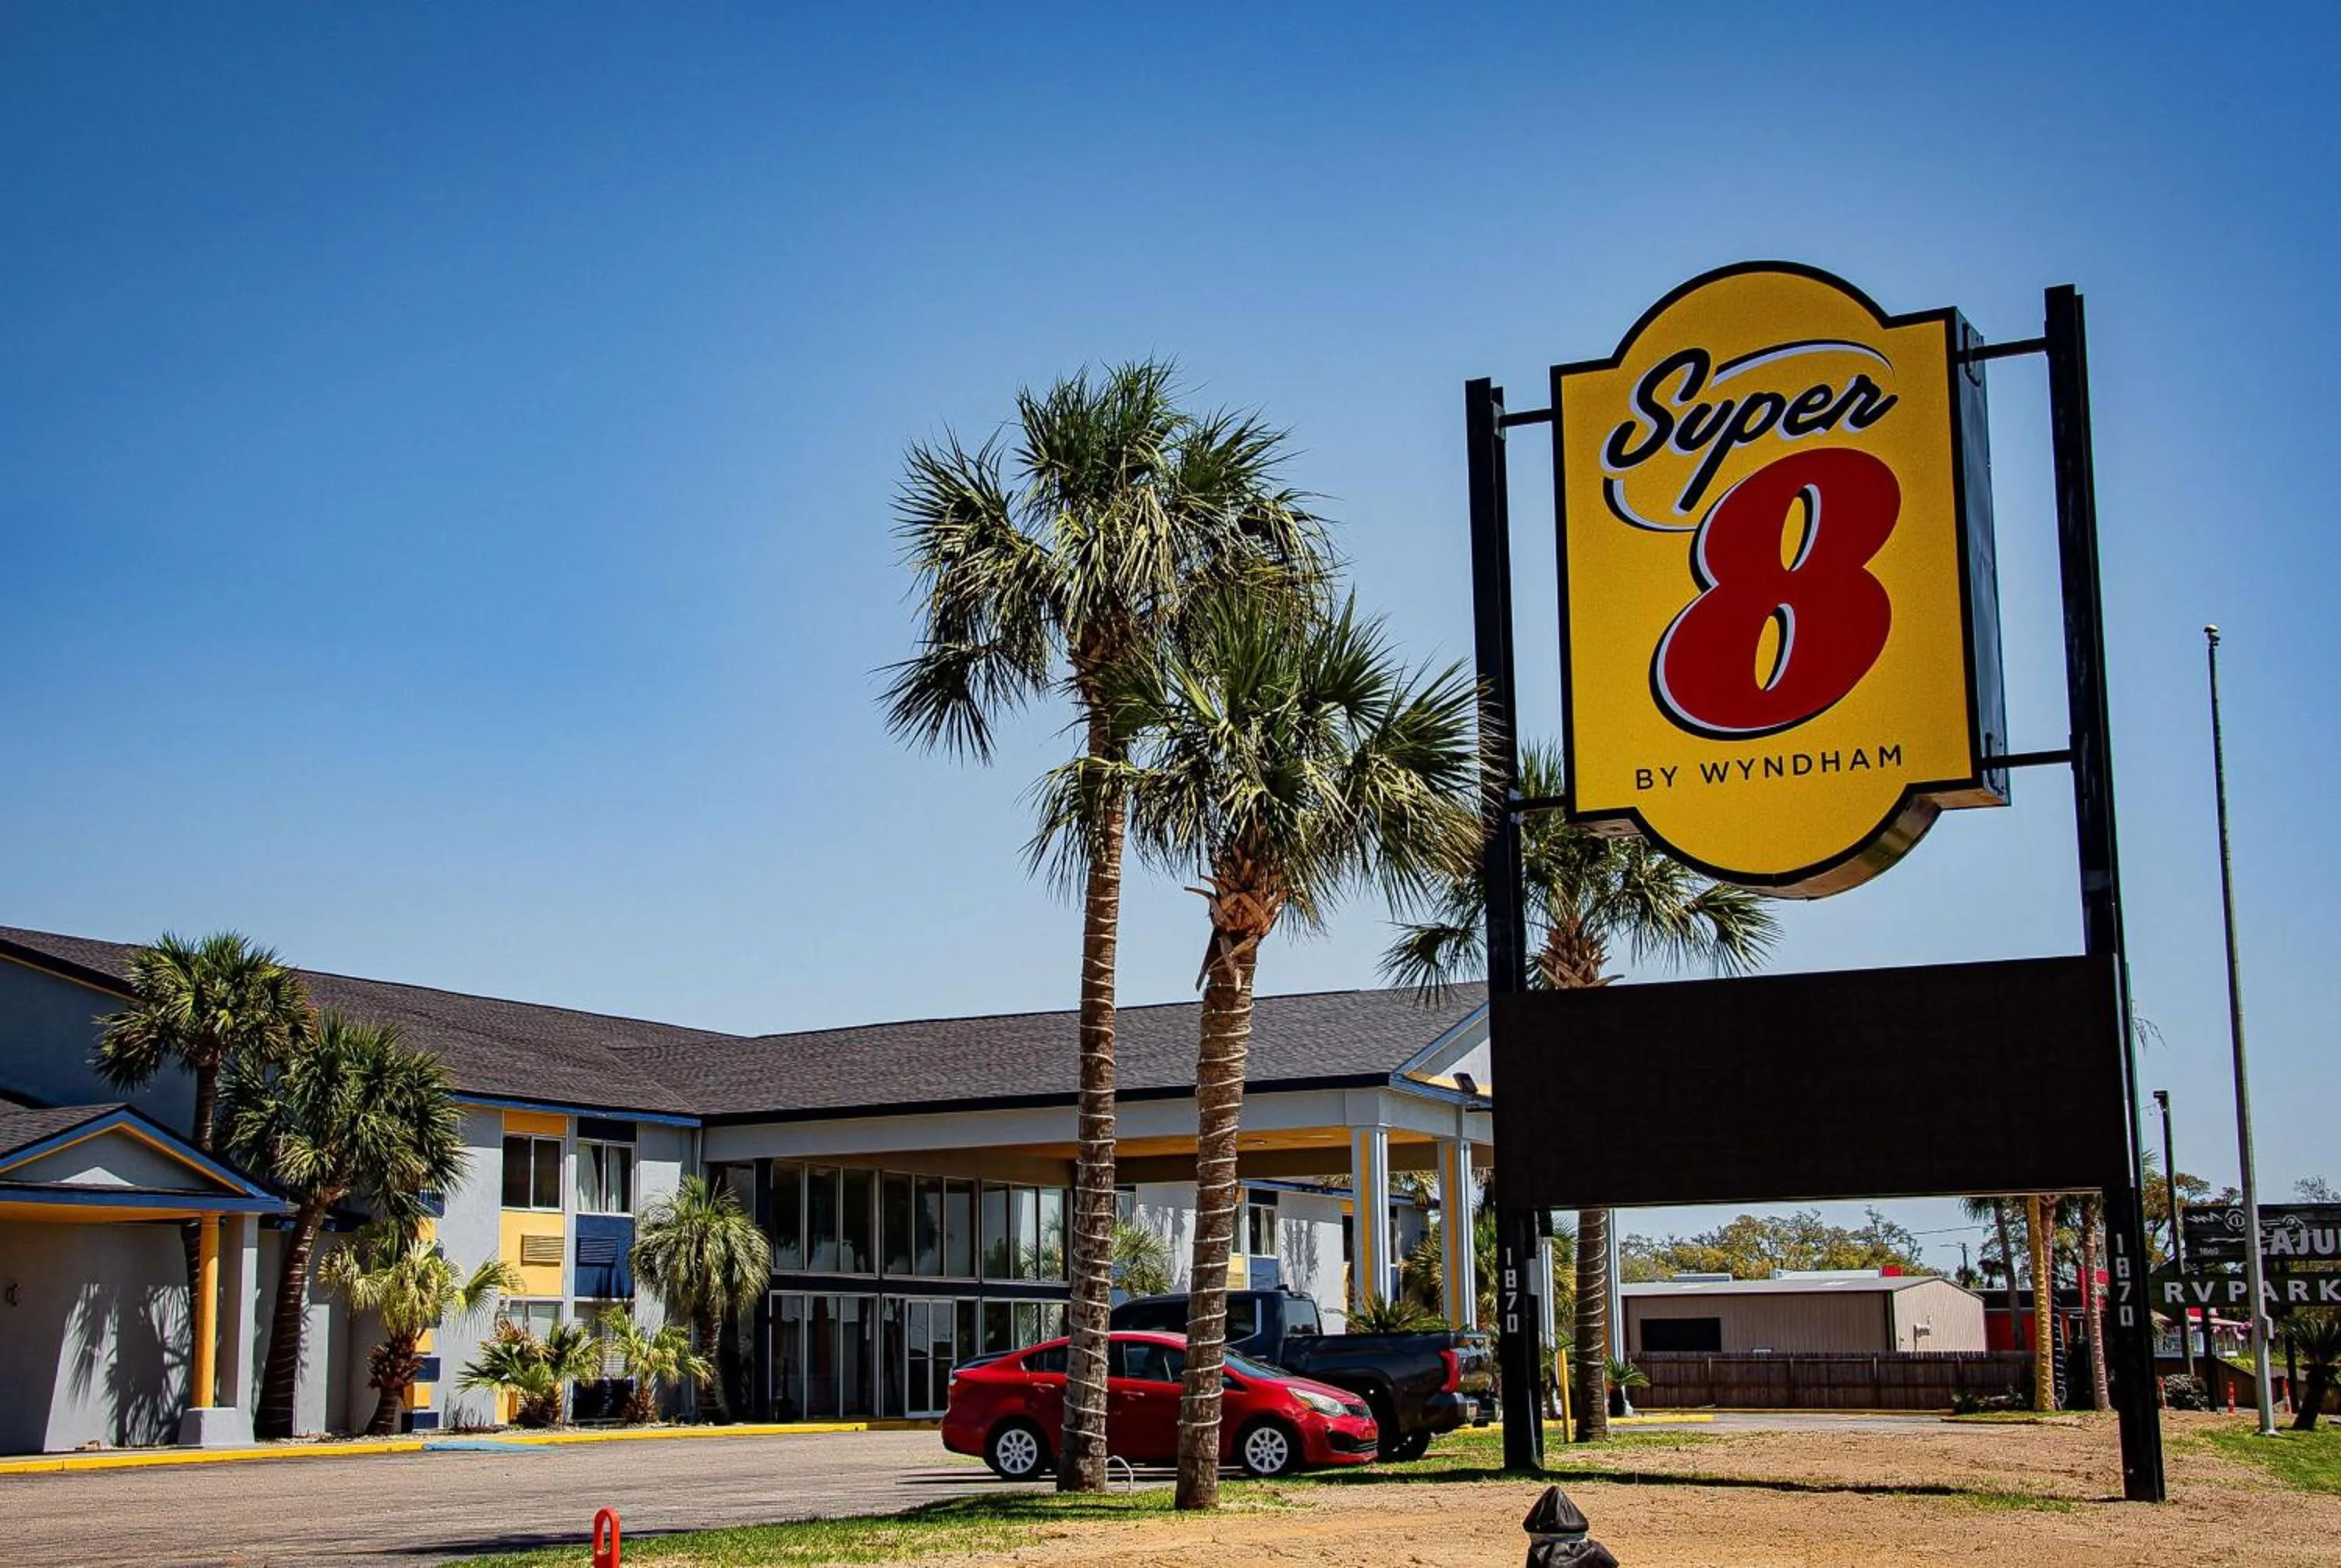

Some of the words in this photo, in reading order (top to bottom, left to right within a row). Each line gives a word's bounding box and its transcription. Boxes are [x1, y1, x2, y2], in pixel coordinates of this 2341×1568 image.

[1600, 347, 1899, 515] Super
[1648, 447, 1902, 742] 8
[1636, 764, 1678, 791] BY
[1700, 744, 1902, 786] WYNDHAM
[2115, 1233, 2134, 1327] 1870
[2260, 1227, 2341, 1255] AJU
[1504, 1247, 1519, 1333] 1870
[2164, 1280, 2215, 1304] RV
